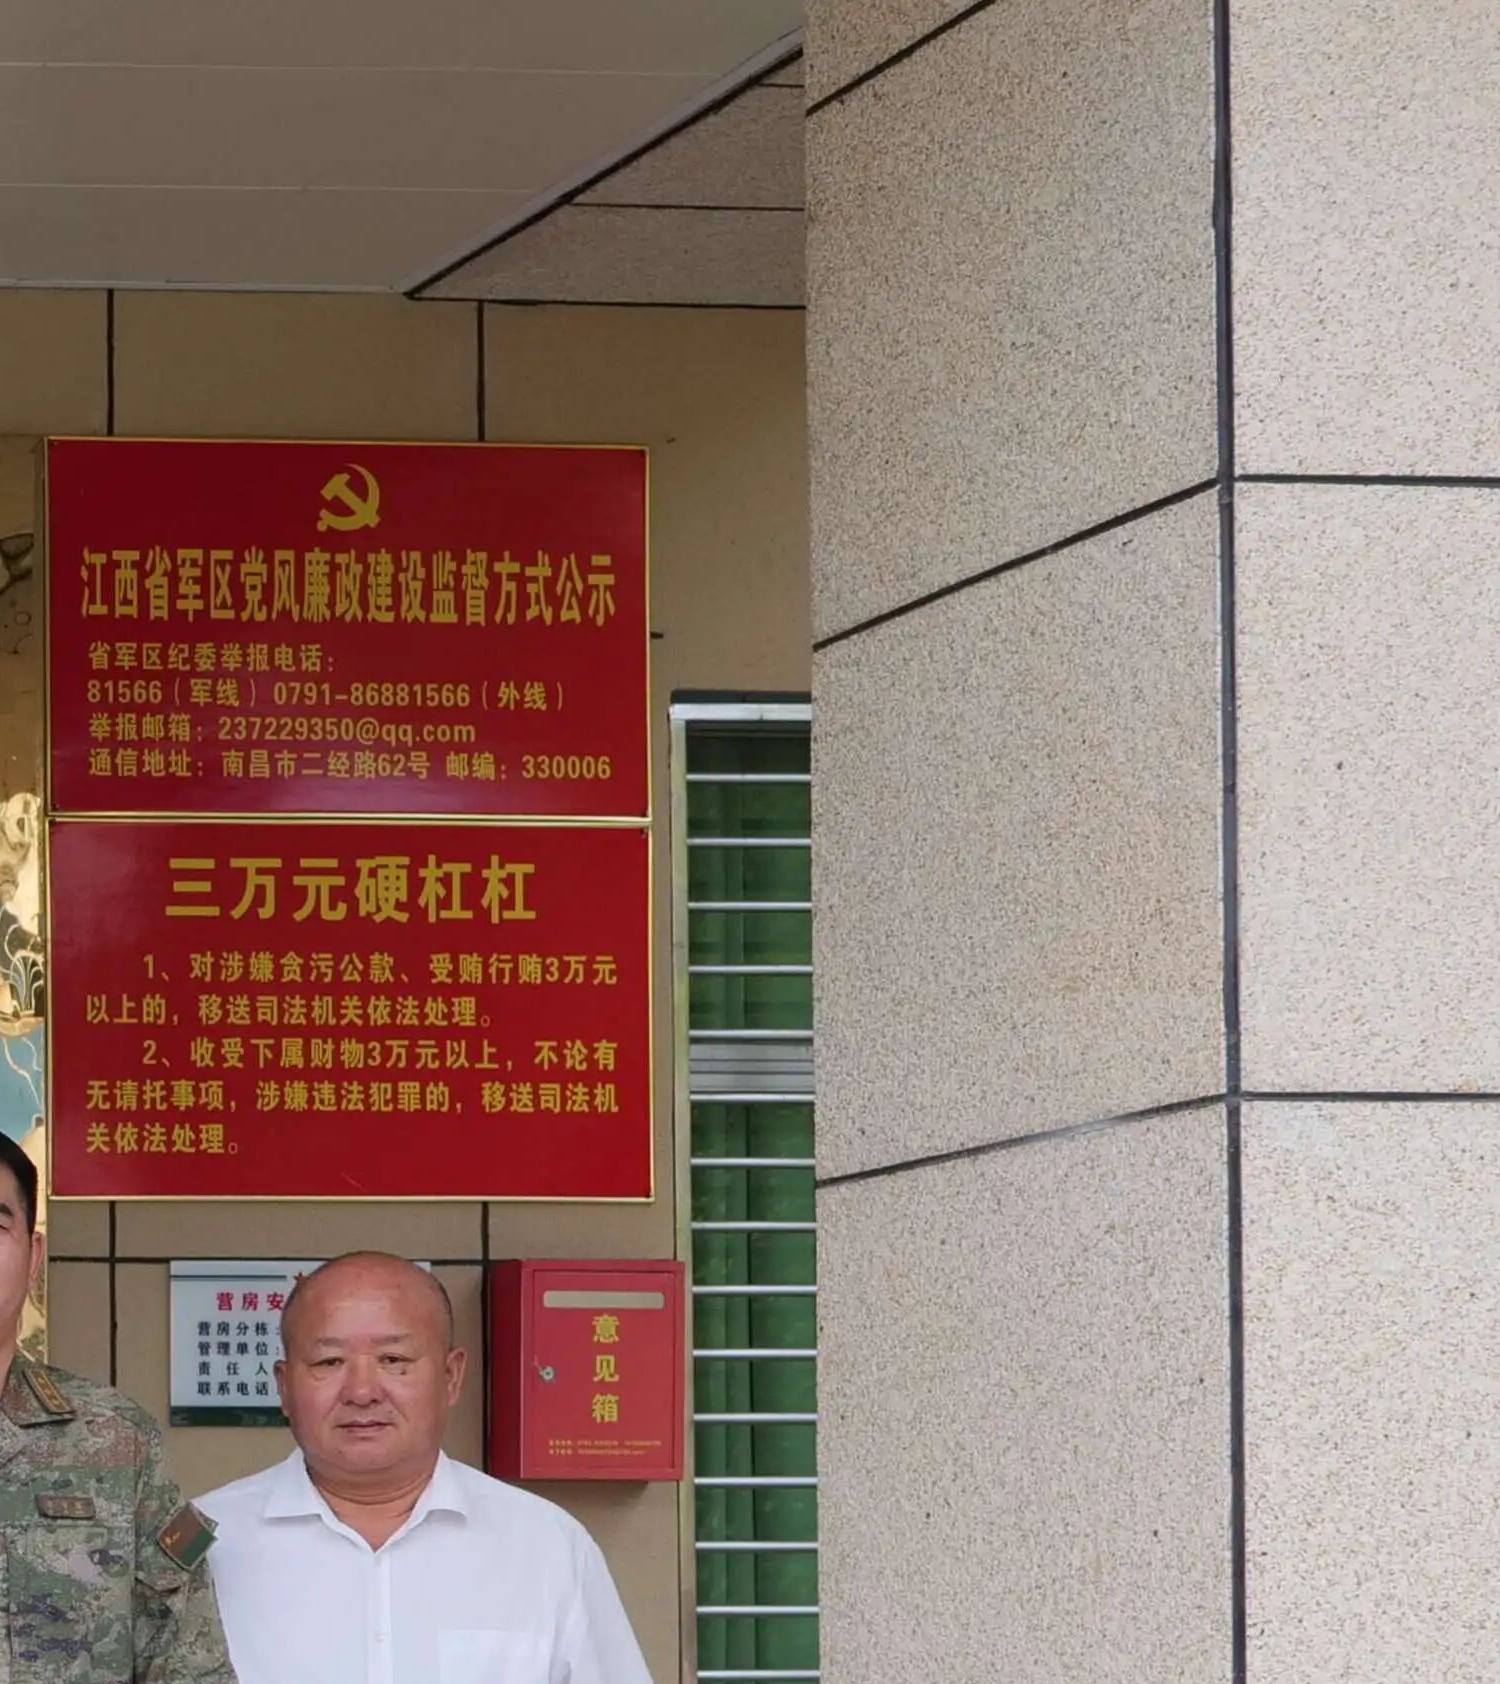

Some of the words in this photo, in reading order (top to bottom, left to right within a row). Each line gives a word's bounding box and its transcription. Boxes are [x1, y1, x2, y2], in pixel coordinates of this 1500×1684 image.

[81, 546, 616, 627] 江西省军区党风廉政建设监督方式公示
[88, 642, 336, 673] 省军区纪委举报电话：
[165, 854, 537, 924] 三万元硬杠杠
[142, 951, 619, 987] 1、对涉嫌贪污公款、受贿行贿3万元
[86, 993, 493, 1028] 以上的，移送司法机关依法处理。
[142, 1038, 619, 1072] 2、收受下属财物3万元以上，不论有
[86, 1080, 619, 1115] 无请托事项，涉嫌违法犯罪的，移送司法机
[86, 1123, 239, 1156] 关依法处理。
[591, 1314, 621, 1424] 意见箱
